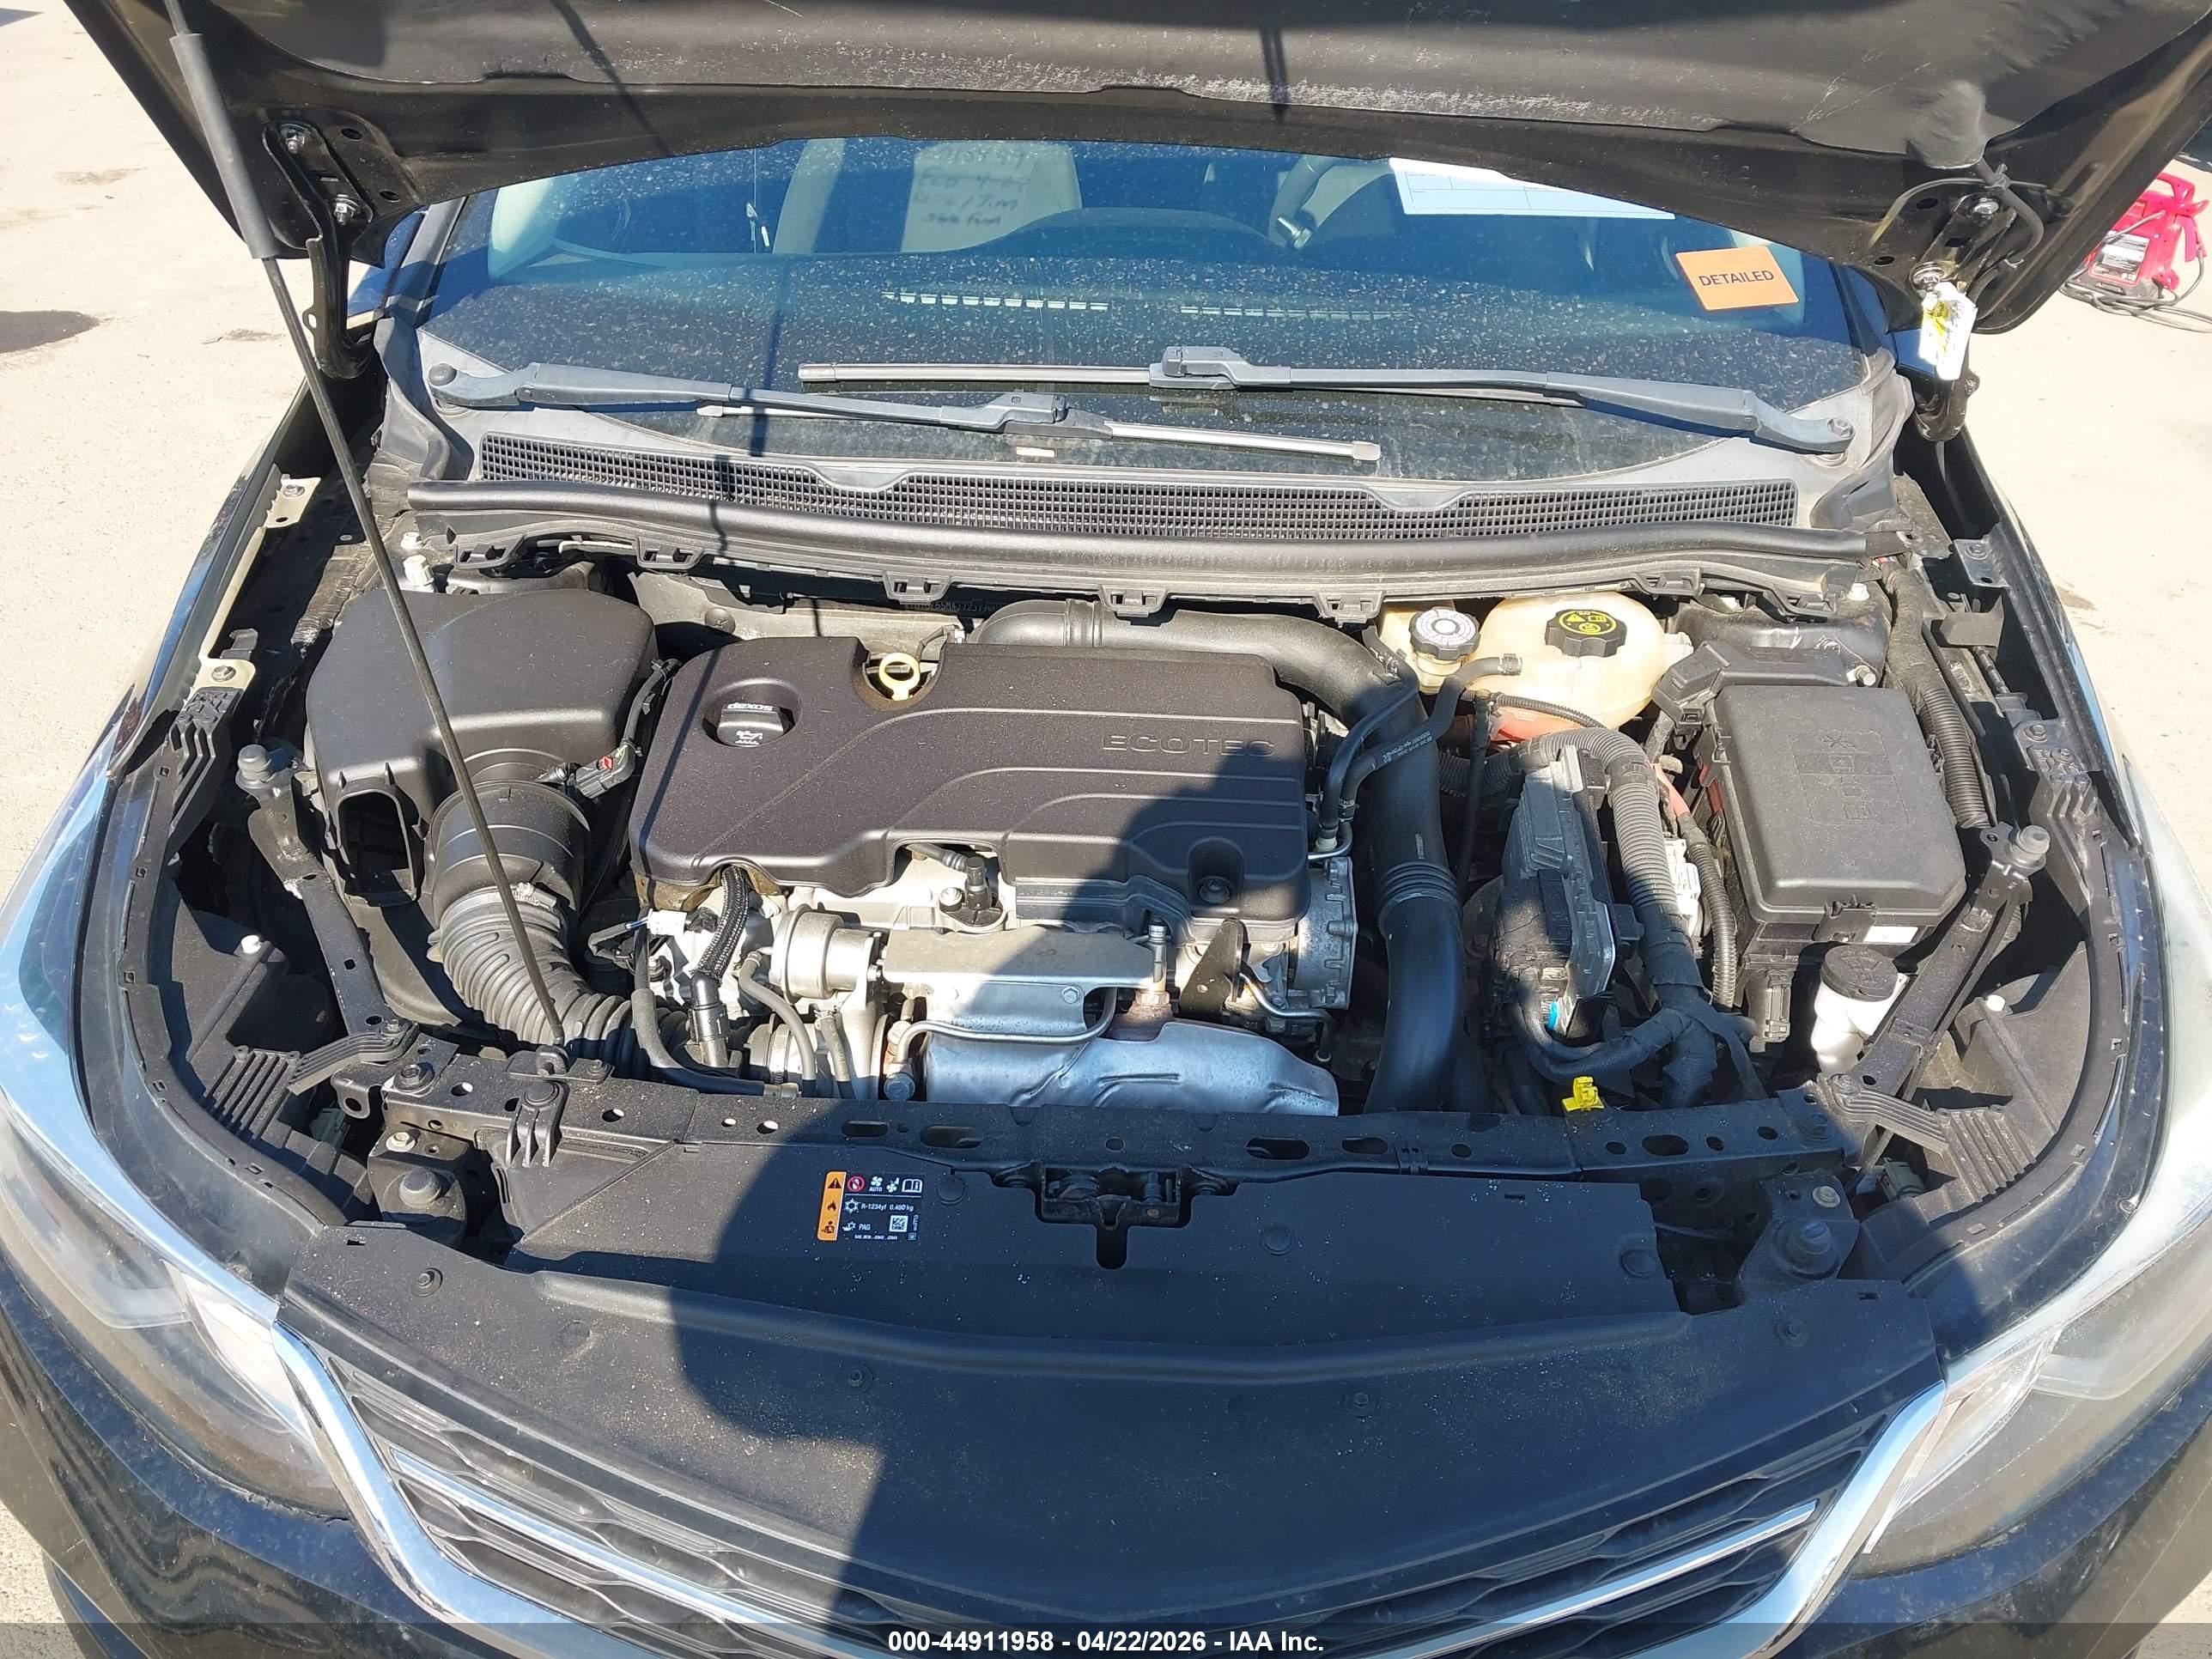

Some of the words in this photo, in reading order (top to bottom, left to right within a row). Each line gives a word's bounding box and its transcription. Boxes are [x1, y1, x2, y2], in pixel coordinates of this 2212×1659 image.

[1698, 270, 1774, 286] DETAILED
[726, 702, 774, 711] dexos
[1103, 734, 1276, 757] ECOTEC
